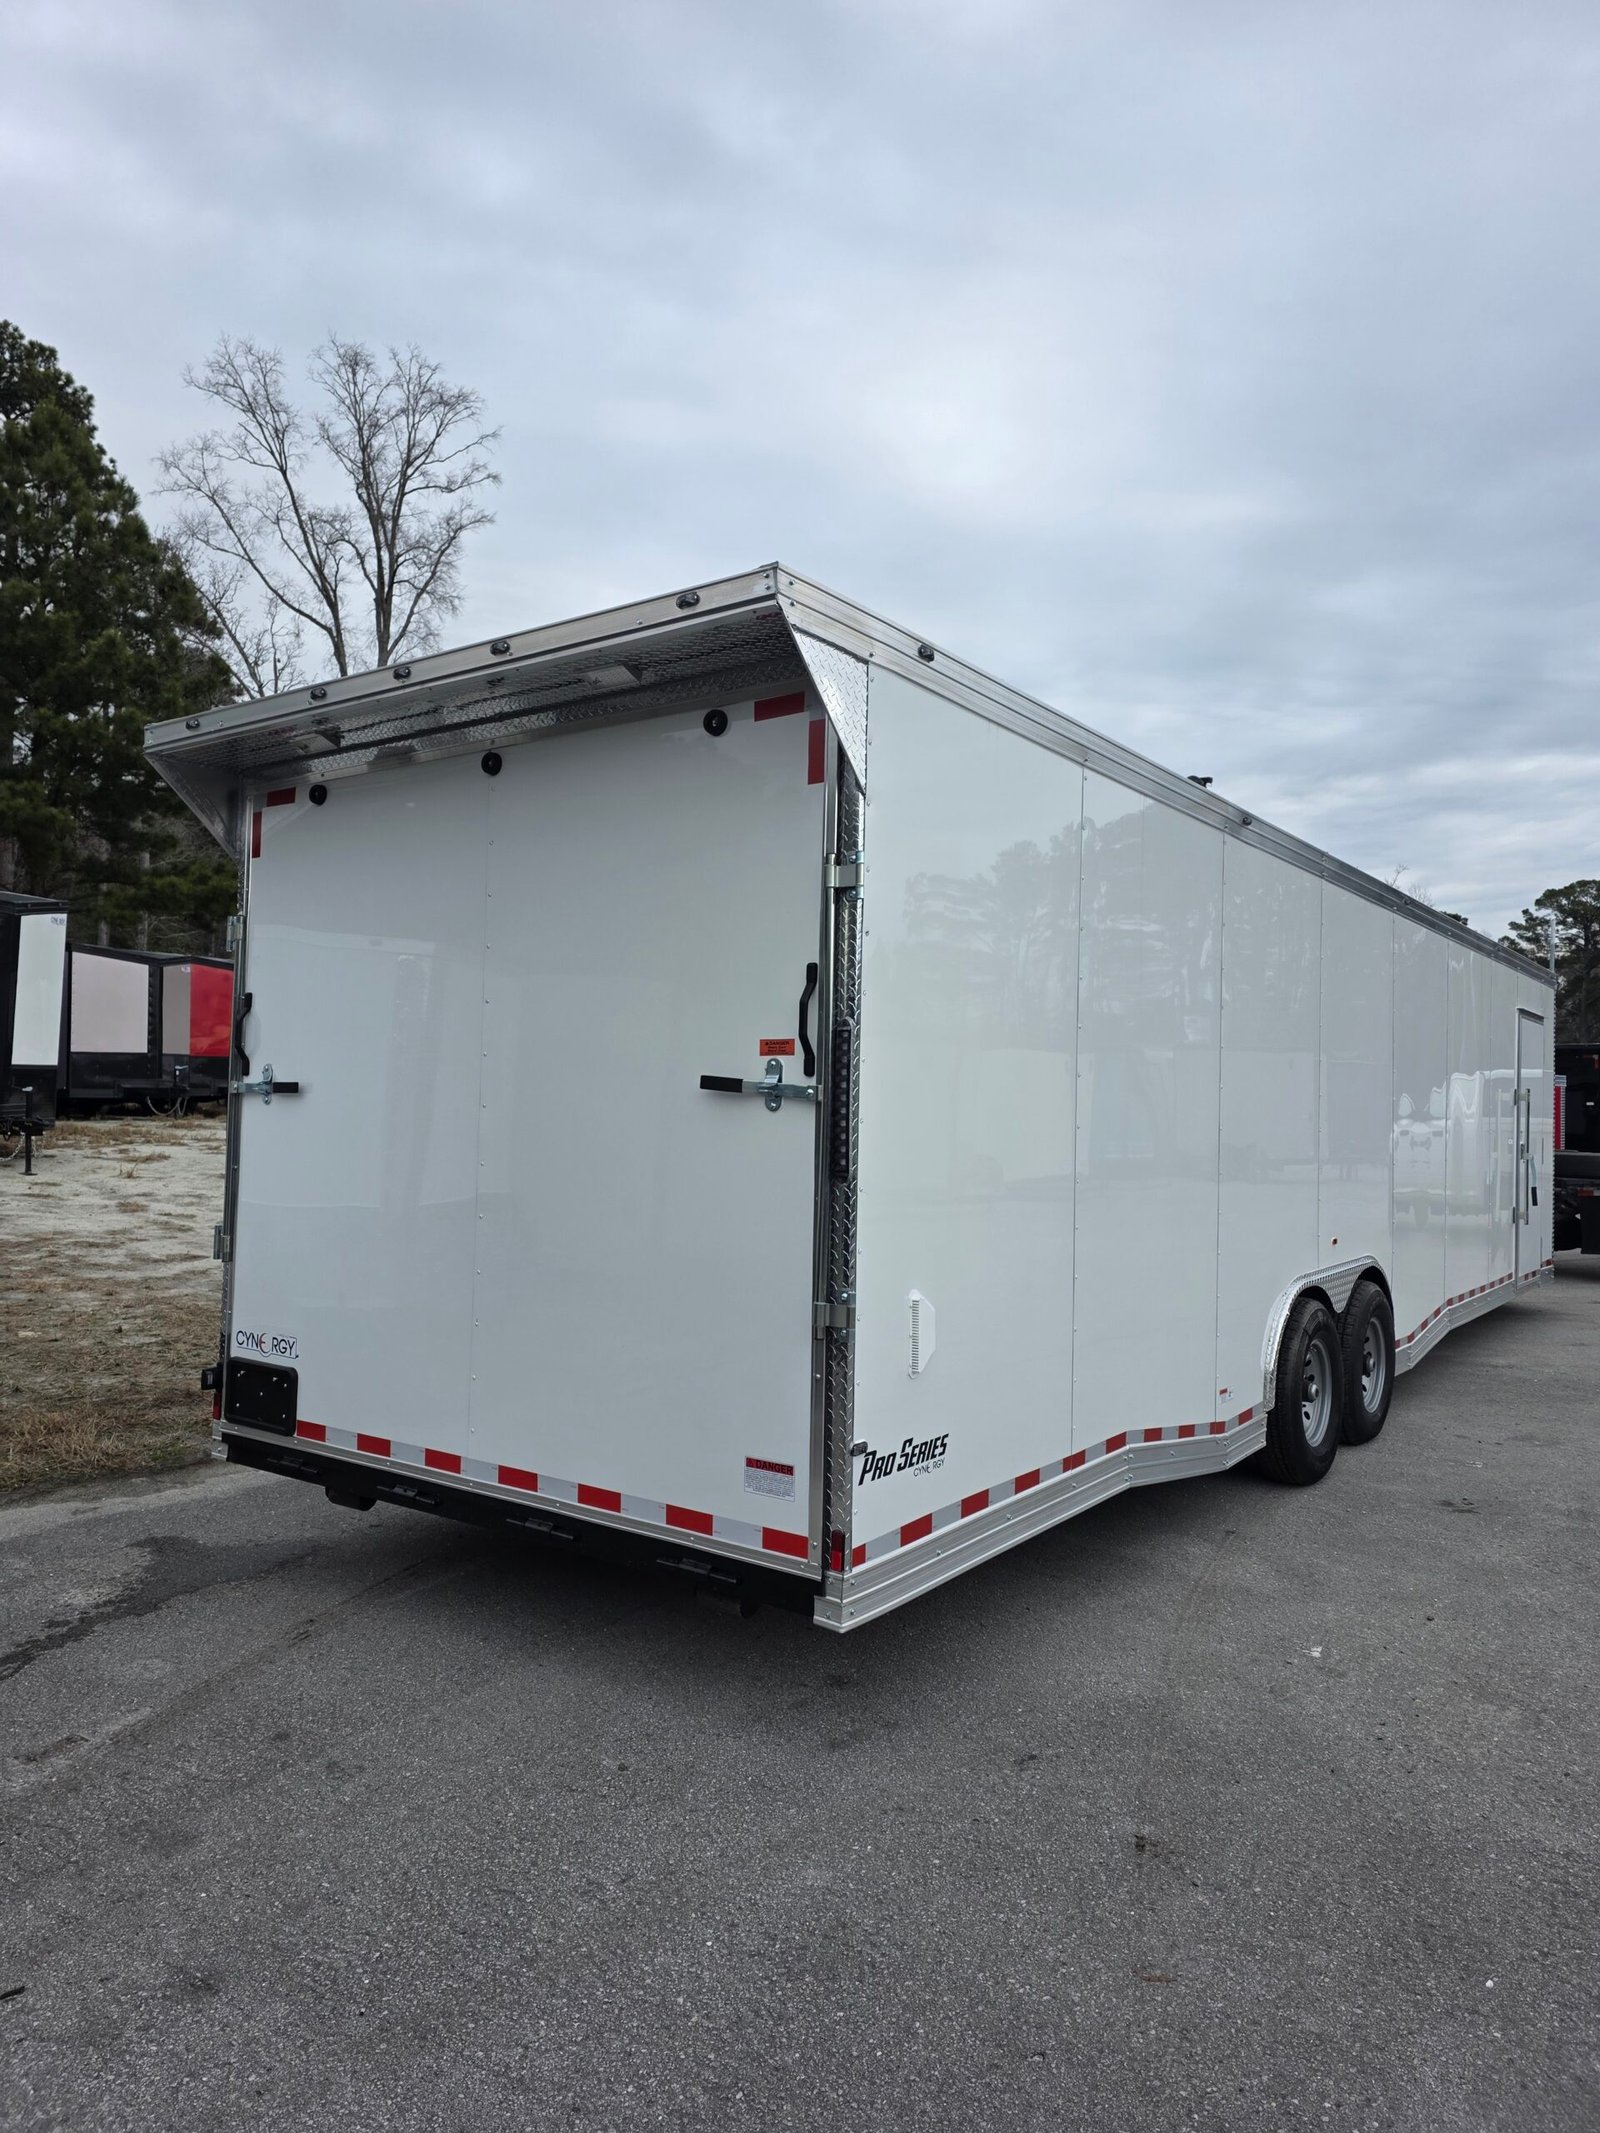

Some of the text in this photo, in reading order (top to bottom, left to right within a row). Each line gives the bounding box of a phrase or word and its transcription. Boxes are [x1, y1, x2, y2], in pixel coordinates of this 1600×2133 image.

[236, 1330, 296, 1356] CYNERGY
[756, 1460, 793, 1476] DANGER
[858, 1433, 949, 1487] PRO SERIES
[913, 1457, 945, 1477] CYNERGY
